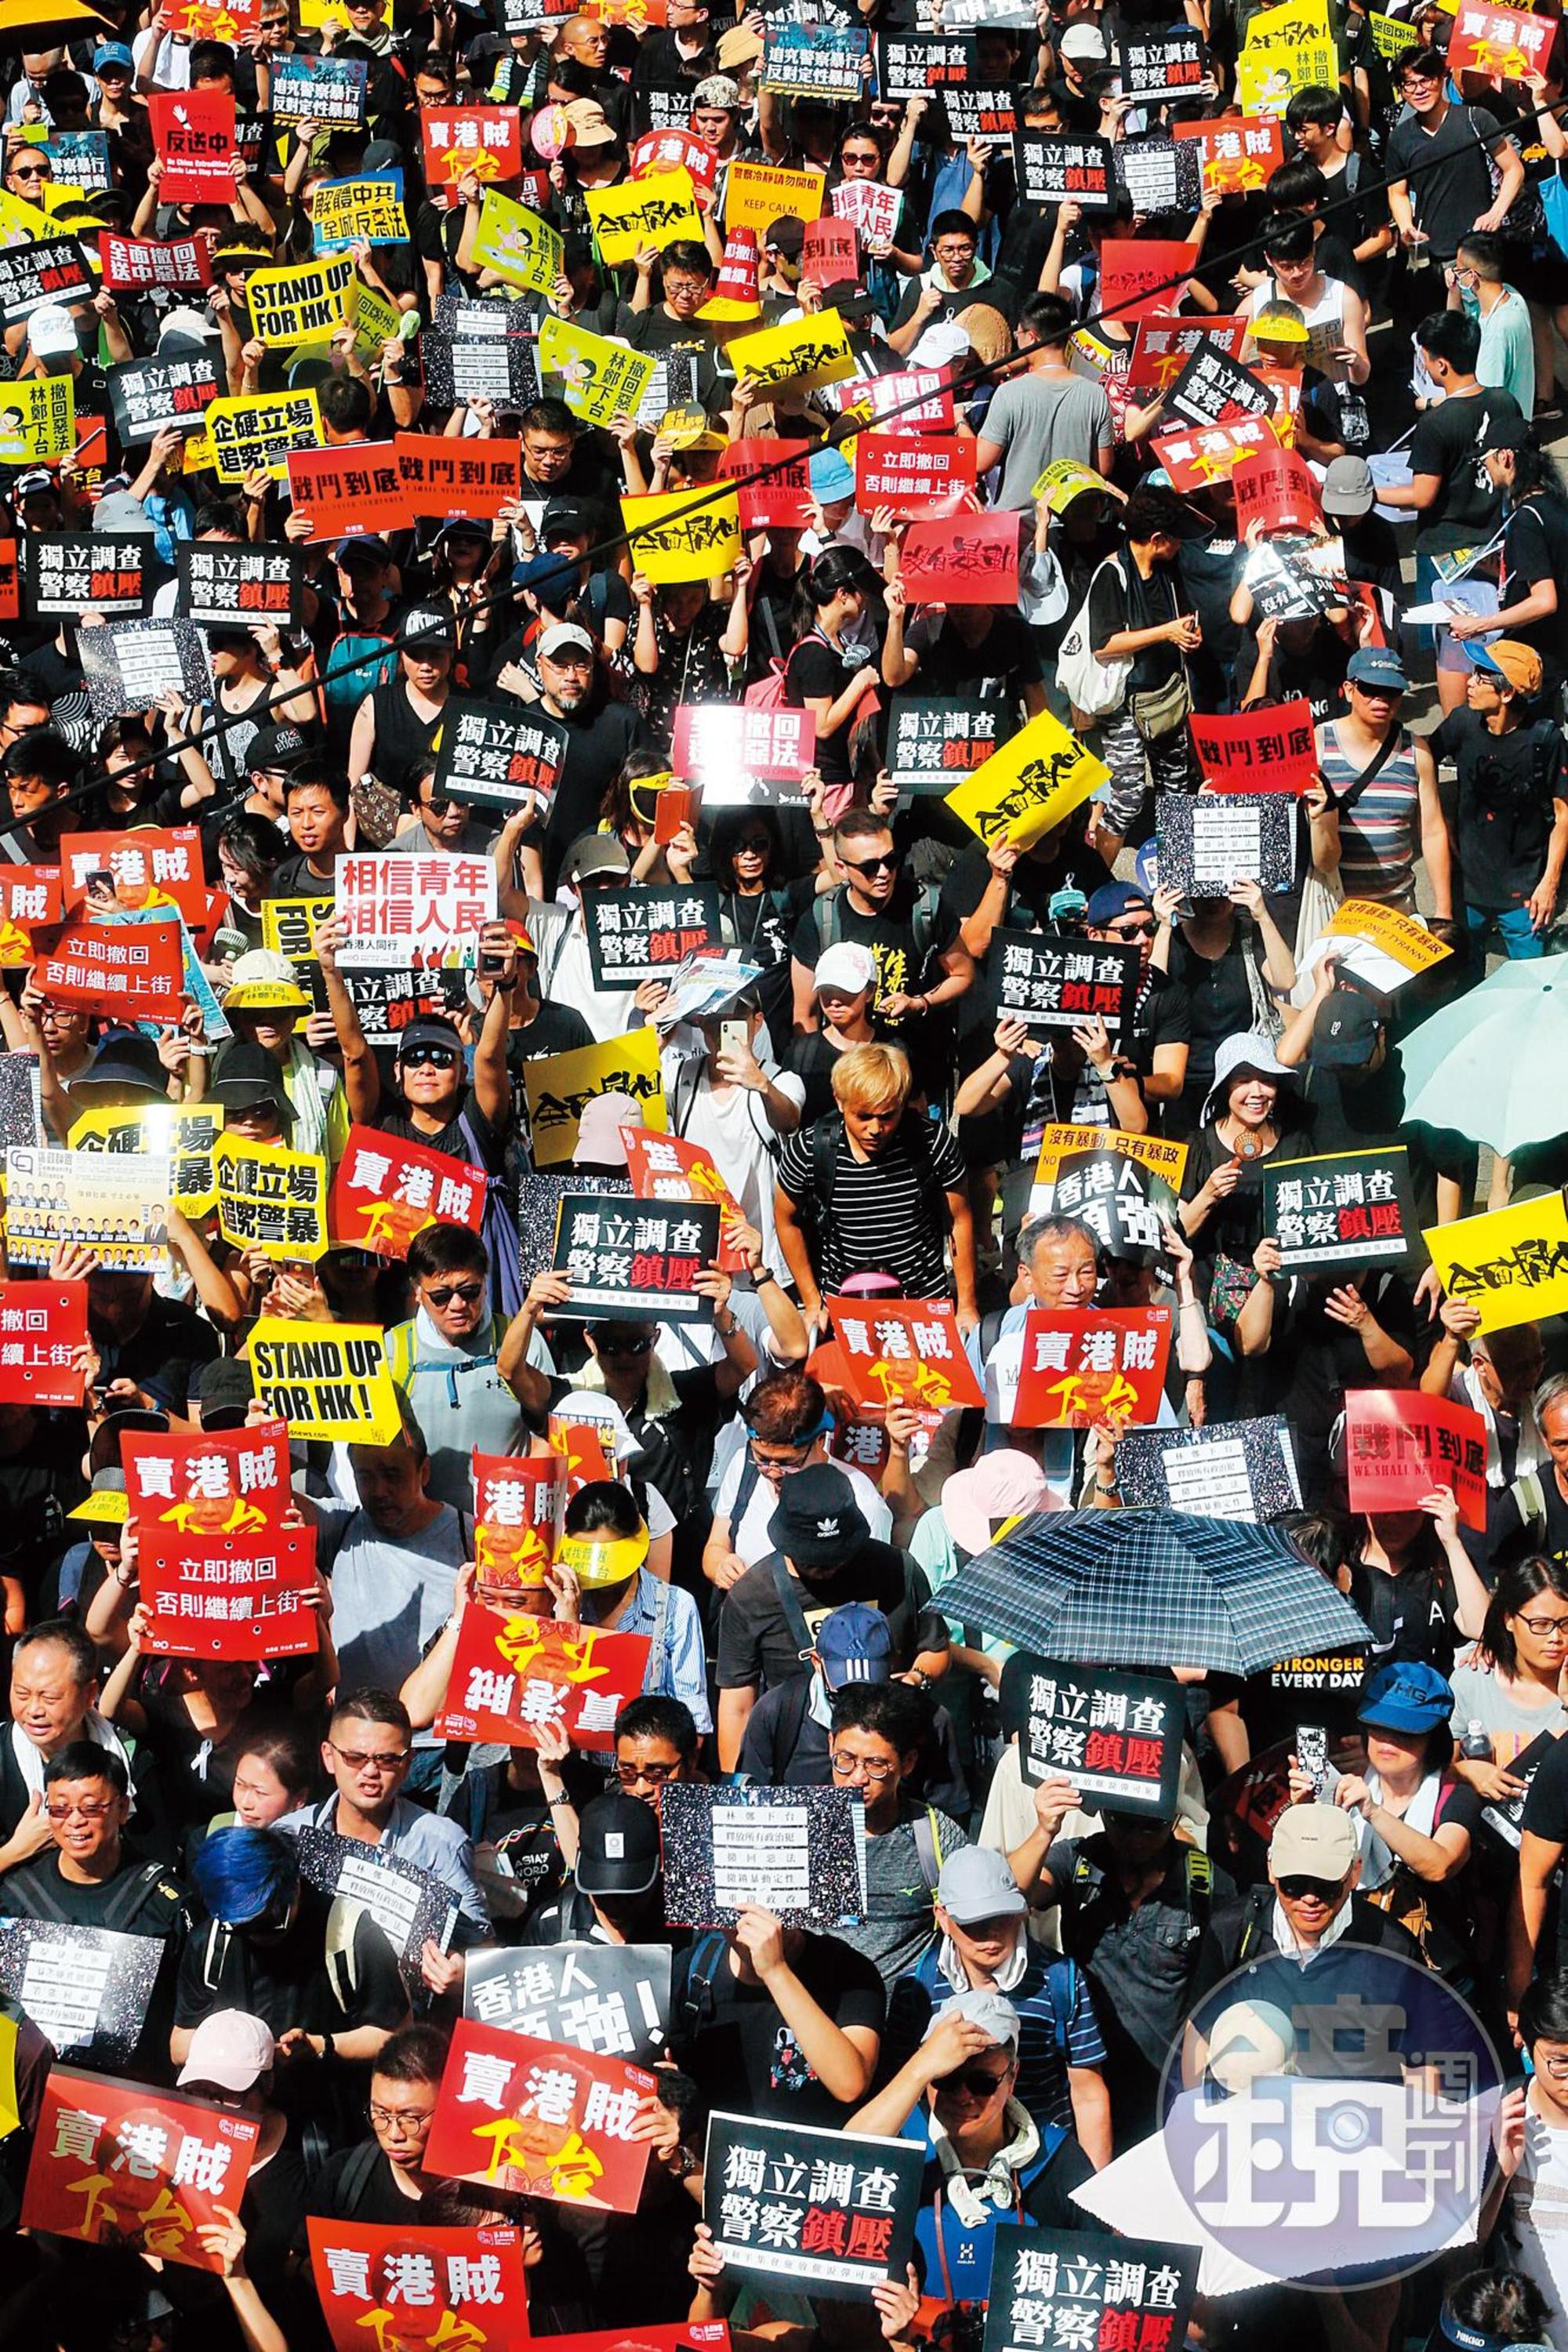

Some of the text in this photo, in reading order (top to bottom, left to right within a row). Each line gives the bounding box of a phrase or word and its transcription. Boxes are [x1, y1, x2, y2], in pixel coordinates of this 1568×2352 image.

[1461, 12, 1544, 52] 賣港賊
[768, 45, 860, 71] 追究警察暴行
[887, 44, 967, 66] 獨立調查
[1128, 43, 1199, 66] 獨立調查
[1468, 41, 1530, 77] 下台
[274, 78, 361, 103] 追究警察暴行
[766, 64, 859, 89] 反對定性暴動
[888, 65, 967, 87] 警察鎮壓
[1131, 63, 1202, 89] 警察鎮壓
[274, 93, 358, 119] 反對定性暴動
[945, 90, 1011, 112] 獨立調查
[428, 118, 510, 149] 賣港賊
[947, 110, 1018, 133] 警察鎮壓
[166, 131, 228, 154] 反送中
[1023, 143, 1105, 168] 獨立調查
[440, 149, 500, 182] 下台
[734, 167, 818, 192] 警察冷靜請勿開槍
[1025, 166, 1107, 191] 警察鎮壓
[1203, 154, 1265, 189] 下台
[314, 186, 394, 214] 解體中共
[744, 199, 798, 215] KEEP CALM
[323, 209, 406, 240] 全城反惡法
[109, 241, 195, 263] 全面撤回
[111, 259, 200, 282] 送中惡法
[0, 265, 83, 305] 警察鎮壓
[252, 265, 354, 309] STAND UP
[257, 307, 299, 336] FOR
[121, 359, 213, 394] 獨立調查
[590, 351, 628, 419] 林鄭下台
[1195, 353, 1269, 417] 獨立調查
[29, 387, 48, 455] 林鄭下台
[50, 384, 70, 452] 撤回惡法
[125, 384, 218, 421] 警察鎮壓
[212, 398, 314, 443] 企硬立場
[218, 430, 318, 474] 追究警暴
[882, 452, 949, 470] 立即撤回
[1164, 421, 1265, 466] 賣港賊
[865, 473, 966, 499] 否則繼續上街
[38, 545, 143, 572] 獨立調查
[190, 554, 291, 582] 獨立調查
[39, 571, 142, 599] 警察鎮壓
[190, 579, 291, 611] 警察鎮壓
[456, 713, 561, 766] 獨立調查
[898, 711, 996, 739] 獨立調查
[895, 741, 996, 770] 警察鎮壓
[1198, 725, 1312, 768] 戰鬥到底
[452, 745, 556, 793] 警察鎮壓
[70, 849, 191, 888] 賣港賊
[343, 860, 488, 898] 相信青年
[343, 899, 485, 936] 相信人民
[597, 898, 706, 933] 獨立調查
[1344, 902, 1443, 954] 沒有暴動 只有暴政
[67, 938, 150, 965] 立即撤回
[599, 930, 708, 965] 警察鎮壓
[1003, 944, 1125, 984] 獨立調查
[1389, 931, 1431, 964] TYRANNY
[45, 961, 172, 996] 否則繼續上街
[1000, 974, 1123, 1014] 警察鎮壓
[1049, 1128, 1180, 1164] 沒有暴動 只有暴政
[217, 1154, 318, 1203] 企硬立場
[347, 1147, 474, 1224] 賣港賊
[1054, 1159, 1145, 1207] 香港人
[1275, 1168, 1396, 1214] 獨立調查
[220, 1194, 319, 1243] 追究警暴
[572, 1212, 702, 1254] 獨立調查
[1276, 1203, 1403, 1248] 警察鎮壓
[567, 1248, 702, 1292] 警察鎮壓
[1, 1308, 48, 1332] 撤回
[838, 1316, 954, 1360] 賣港賊
[1, 1341, 74, 1368] 續上街
[254, 1340, 383, 1382] STAND UP
[1033, 1330, 1160, 1374] 賣港賊
[866, 1361, 953, 1406] 下台
[1045, 1374, 1138, 1425] 下台
[260, 1385, 314, 1423] FOR
[1352, 1423, 1487, 1476] 戰鬥到底
[134, 1445, 278, 1500] 賣港賊
[1354, 1465, 1410, 1477] WE SHALL
[158, 1497, 268, 1534] 下台
[178, 1556, 277, 1585] 立即撤回
[155, 1589, 300, 1623] 否則繼續上街
[494, 1616, 611, 1684] 下台
[1272, 1657, 1364, 1674] STRONGER
[1271, 1671, 1364, 1689] EVERY DAY
[463, 1665, 626, 1733] 賣港賊
[1029, 1673, 1167, 1738] 獨立調查
[1028, 1715, 1166, 1780] 警察鎮壓
[471, 1954, 597, 2020] 香港人
[455, 2051, 641, 2142] 賣港賊
[49, 2107, 232, 2196] 賣港賊
[471, 2117, 604, 2198] 下台
[723, 2143, 900, 2213] 獨立調查
[65, 2173, 194, 2256] 下台
[720, 2192, 895, 2263] 警察鎮壓
[323, 2247, 504, 2307] 賣港賊
[1011, 2248, 1181, 2311] 獨立調查
[1009, 2297, 1174, 2352] 警察鎮壓
[1456, 2329, 1486, 2347] NIKKO
